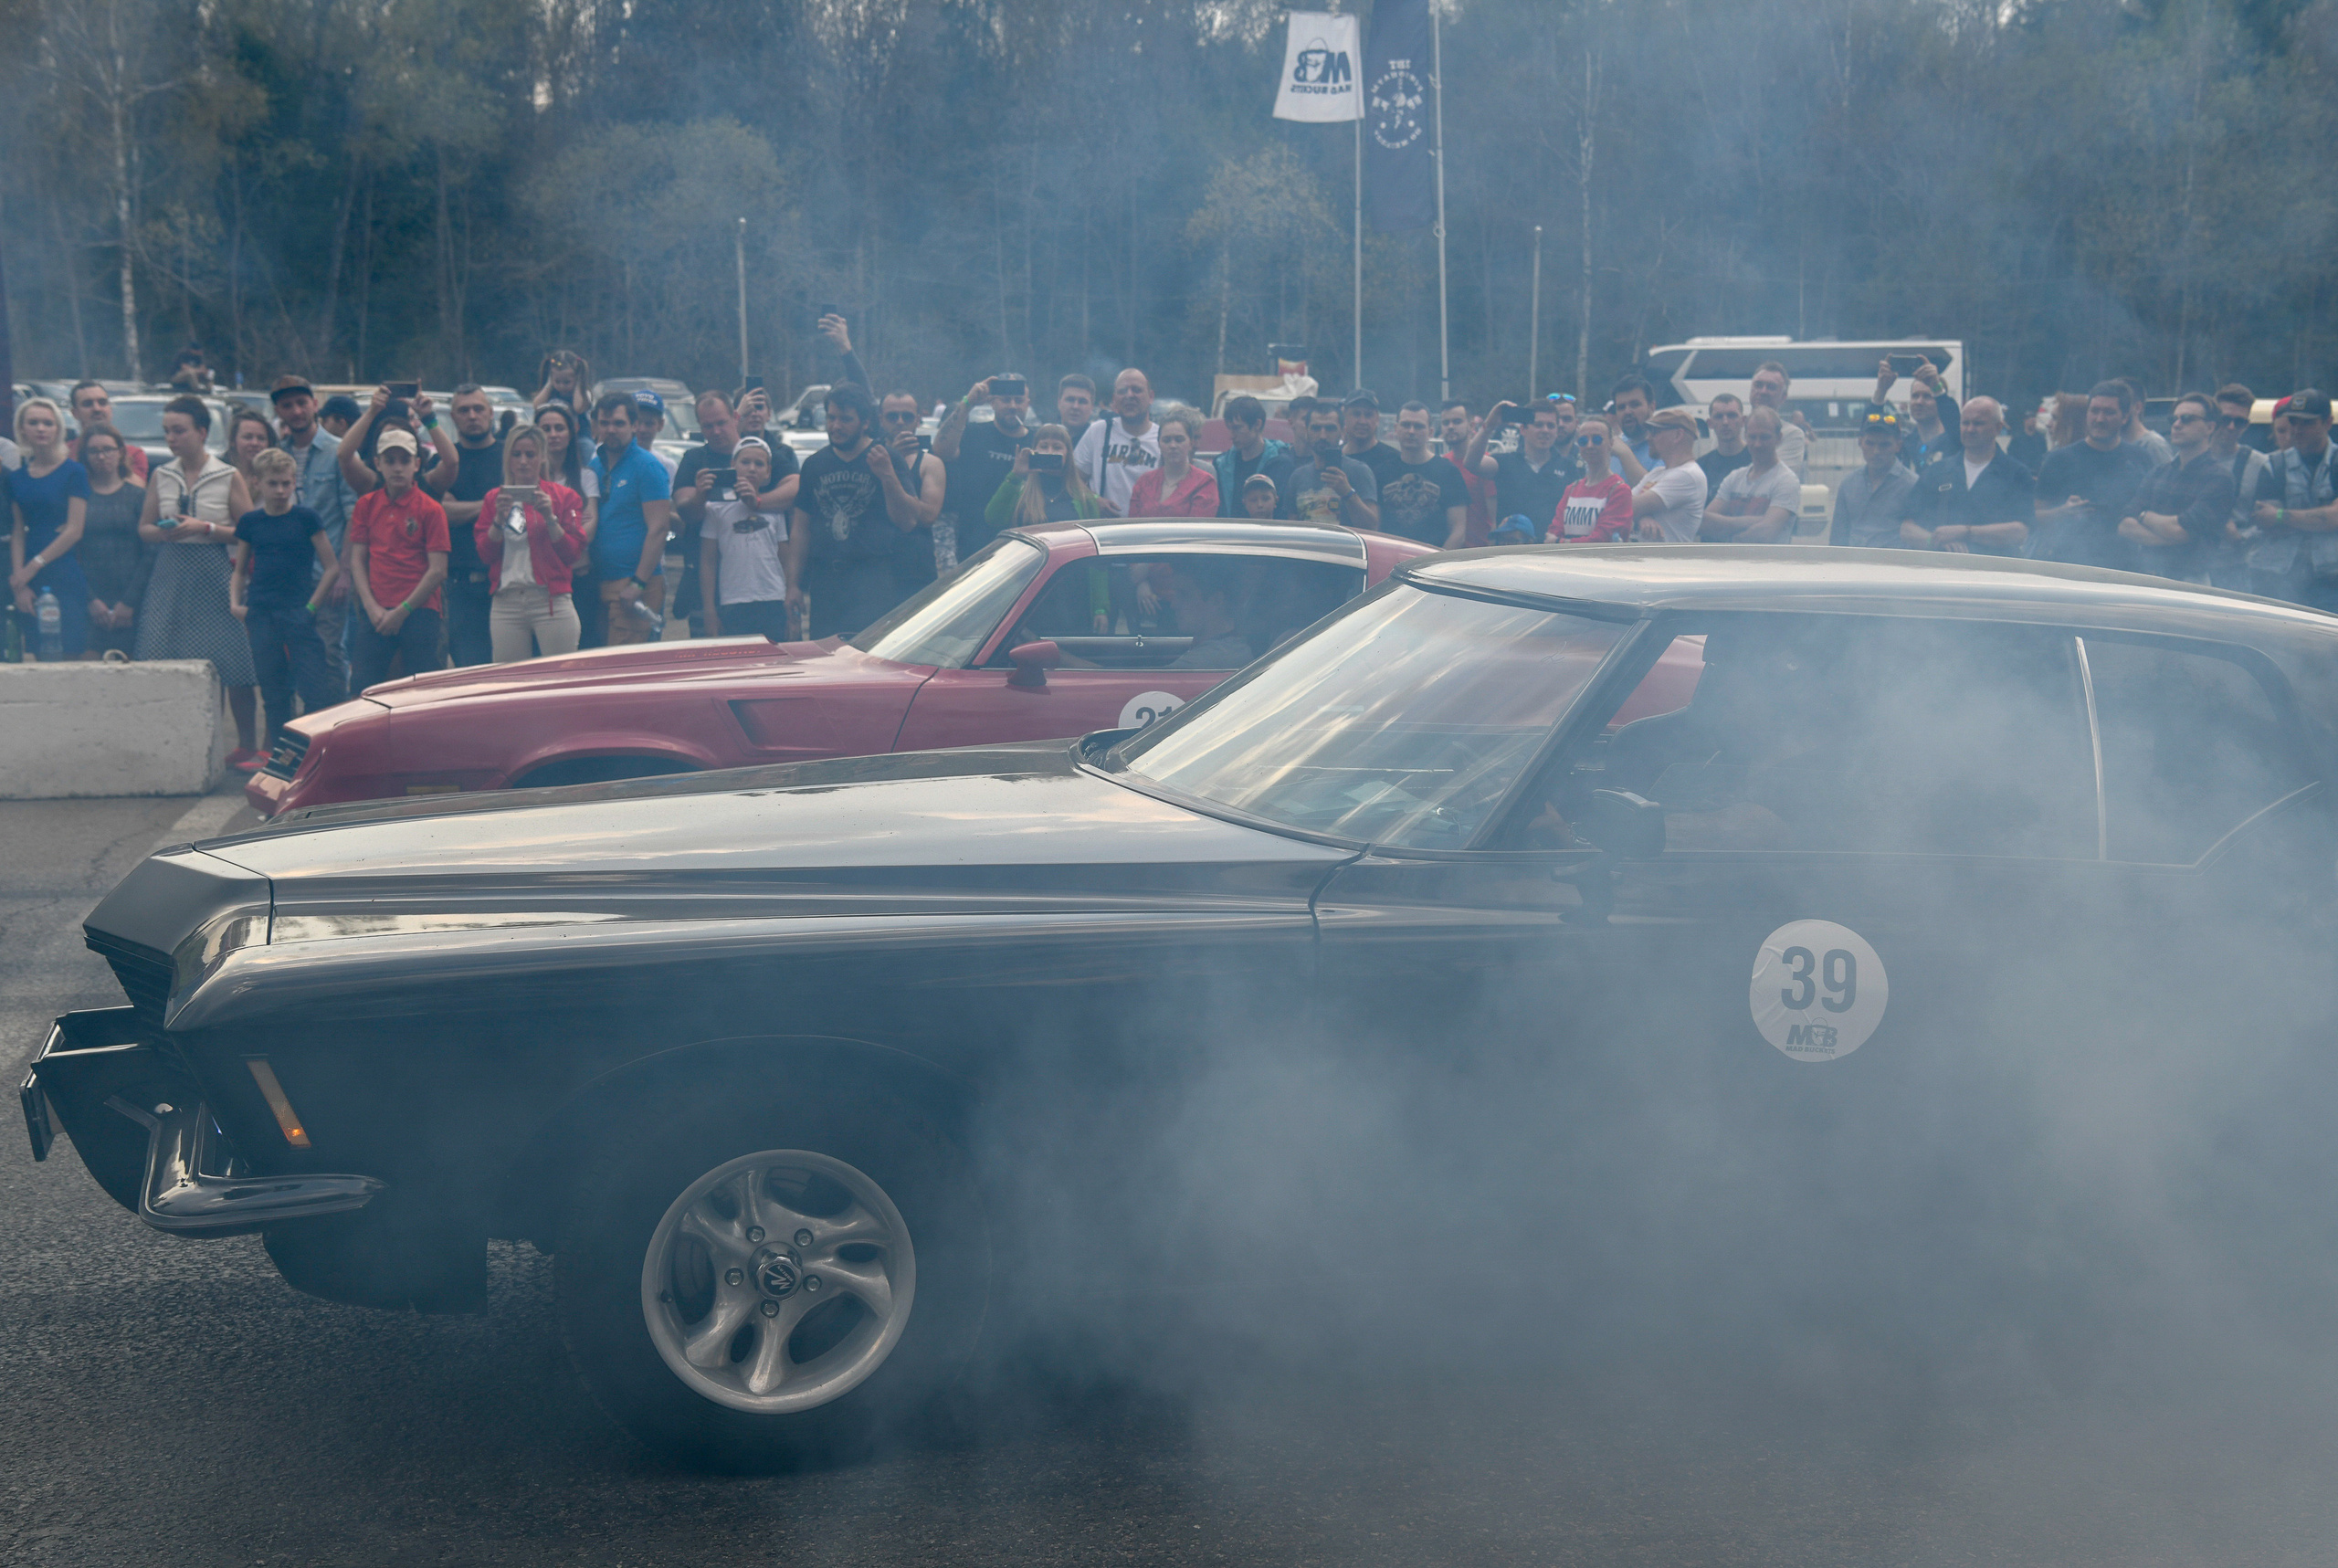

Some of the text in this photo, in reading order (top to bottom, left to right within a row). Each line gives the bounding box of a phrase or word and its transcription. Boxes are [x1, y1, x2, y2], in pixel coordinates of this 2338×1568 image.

[819, 470, 871, 485] MOTO CAR
[1135, 706, 1173, 729] 2
[1781, 946, 1857, 1014] 39
[1805, 1047, 1836, 1055] BUCKETS
